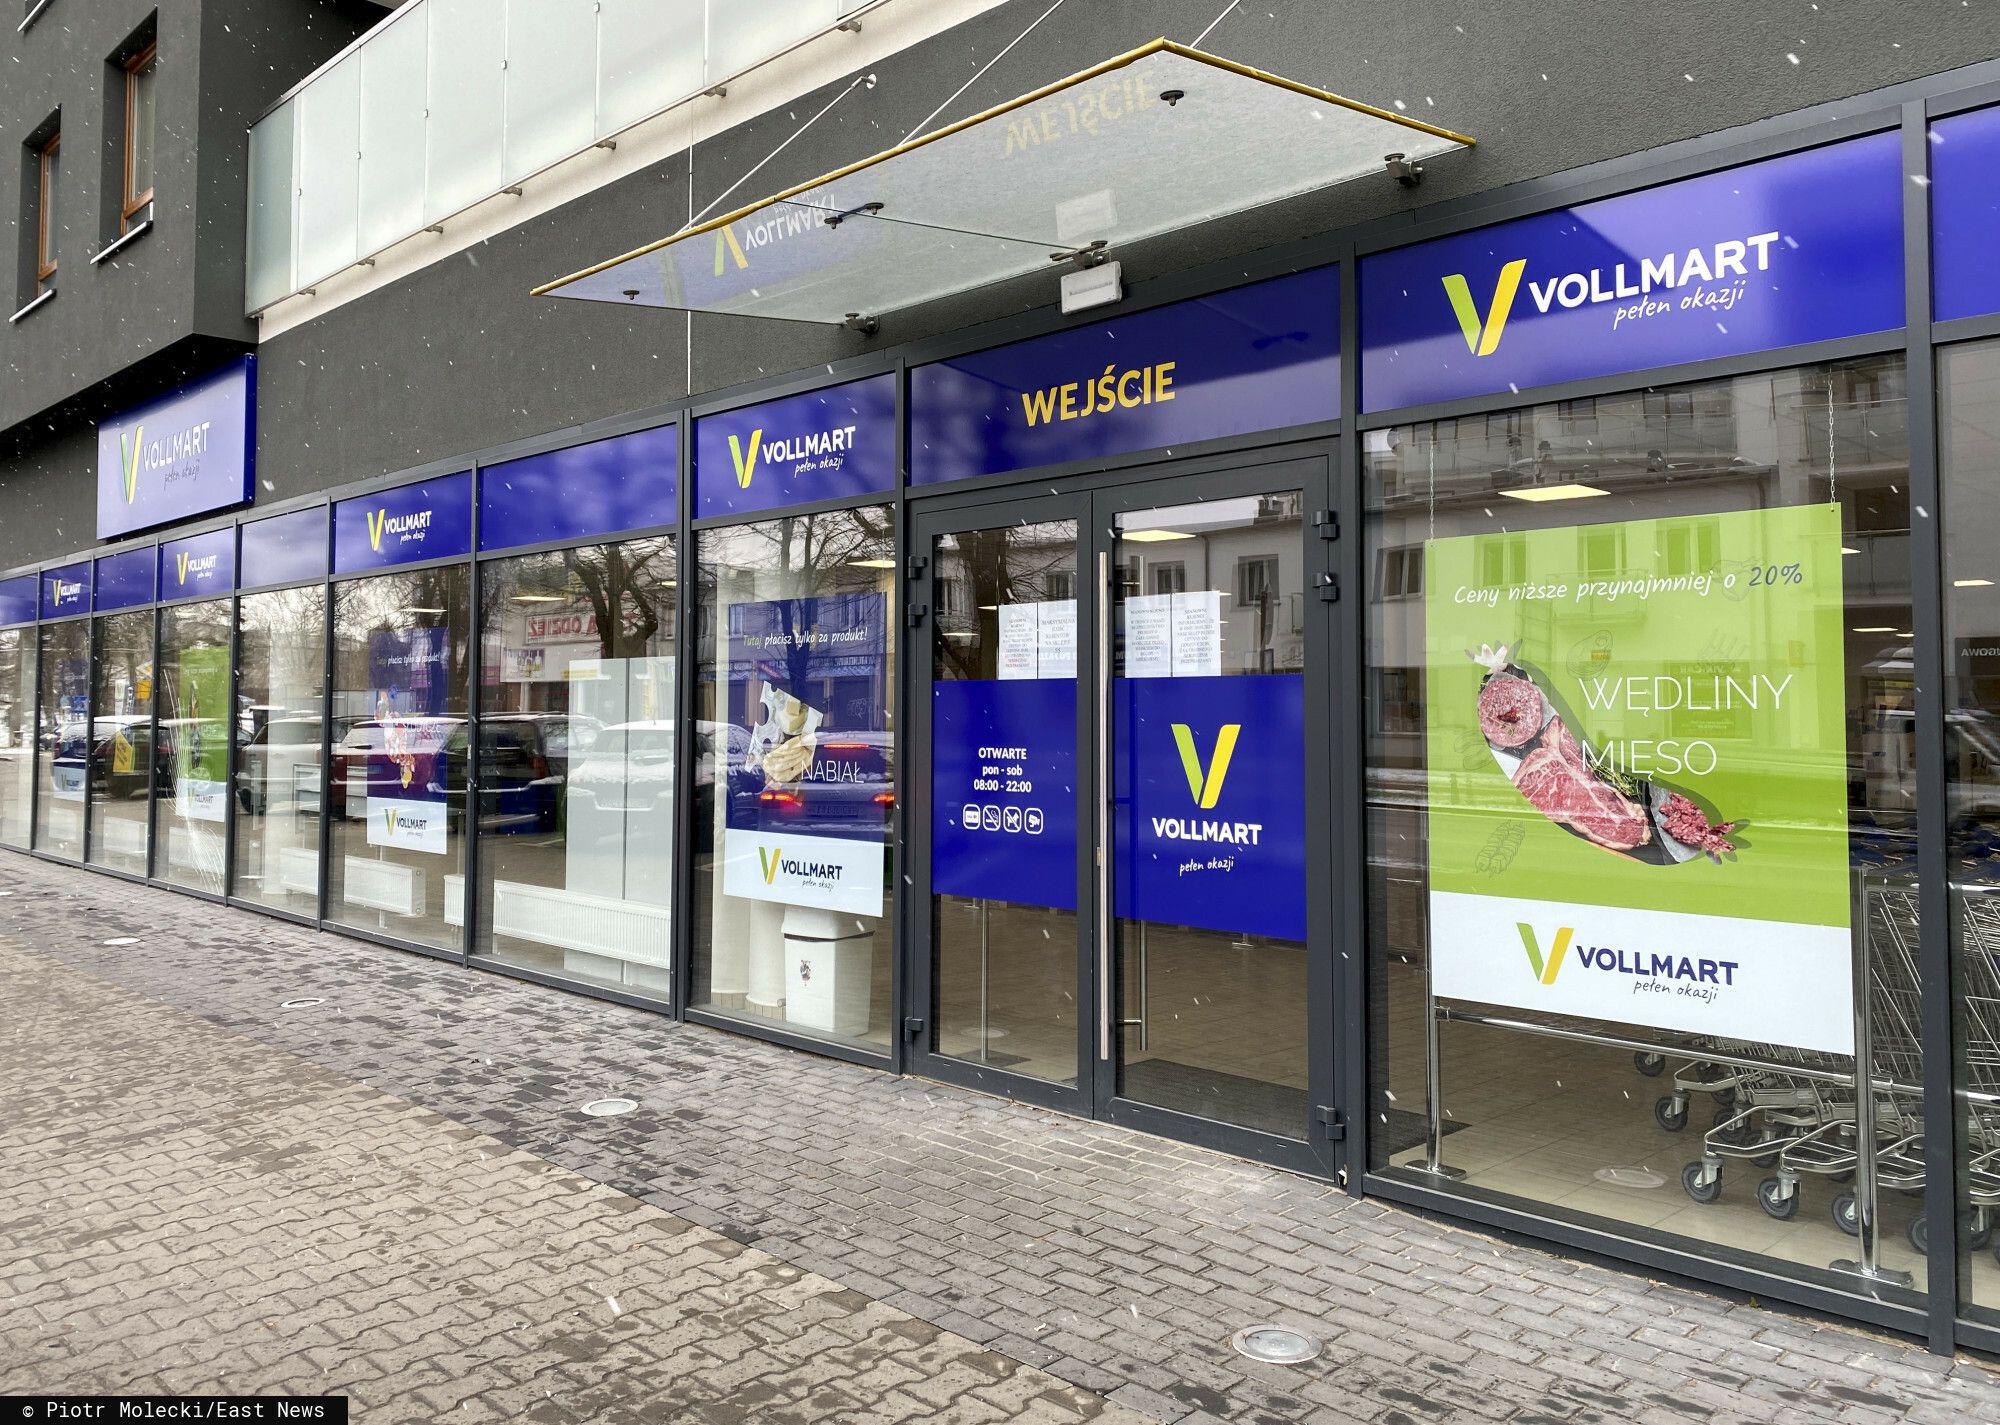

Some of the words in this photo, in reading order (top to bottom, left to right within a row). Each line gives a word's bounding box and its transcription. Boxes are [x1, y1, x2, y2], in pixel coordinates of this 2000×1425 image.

[1528, 231, 1779, 313] VOLLMART
[1612, 294, 1671, 331] pełen
[1680, 279, 1747, 311] okazji
[1021, 361, 1176, 427] WEJŚCIE
[143, 421, 210, 472] VOLLMART
[762, 426, 856, 464] VOLLMART
[794, 457, 817, 479] pełen
[819, 453, 844, 471] okazji
[384, 510, 432, 535] VOLLMART
[1454, 584, 1501, 608] Ceny
[1507, 580, 1568, 601] niższe
[1576, 570, 1714, 604] przynajmniej
[1723, 573, 1737, 589] o
[1748, 563, 1803, 587] 20%
[764, 632, 792, 649] płacisz
[818, 633, 829, 643] za
[831, 626, 868, 646] produkt!
[1577, 673, 1793, 717] WĘDLINY
[978, 747, 1027, 760] OTWARTE
[1581, 740, 1717, 781] MIĘSO
[800, 760, 865, 784] NABIAŁ
[982, 766, 999, 776] pon
[1006, 764, 1023, 776] sob
[973, 779, 999, 791] 08:00
[1005, 780, 1032, 793] 22:00
[396, 816, 427, 831] VOLLMART
[1151, 817, 1262, 846] VOLLMART
[781, 859, 843, 881] VOLLMART
[1179, 858, 1204, 877] pełen
[1207, 855, 1235, 872] okazji
[1576, 945, 1738, 986] VOLLMART
[1633, 978, 1670, 995] pełen
[1677, 983, 1719, 1004] okazji
